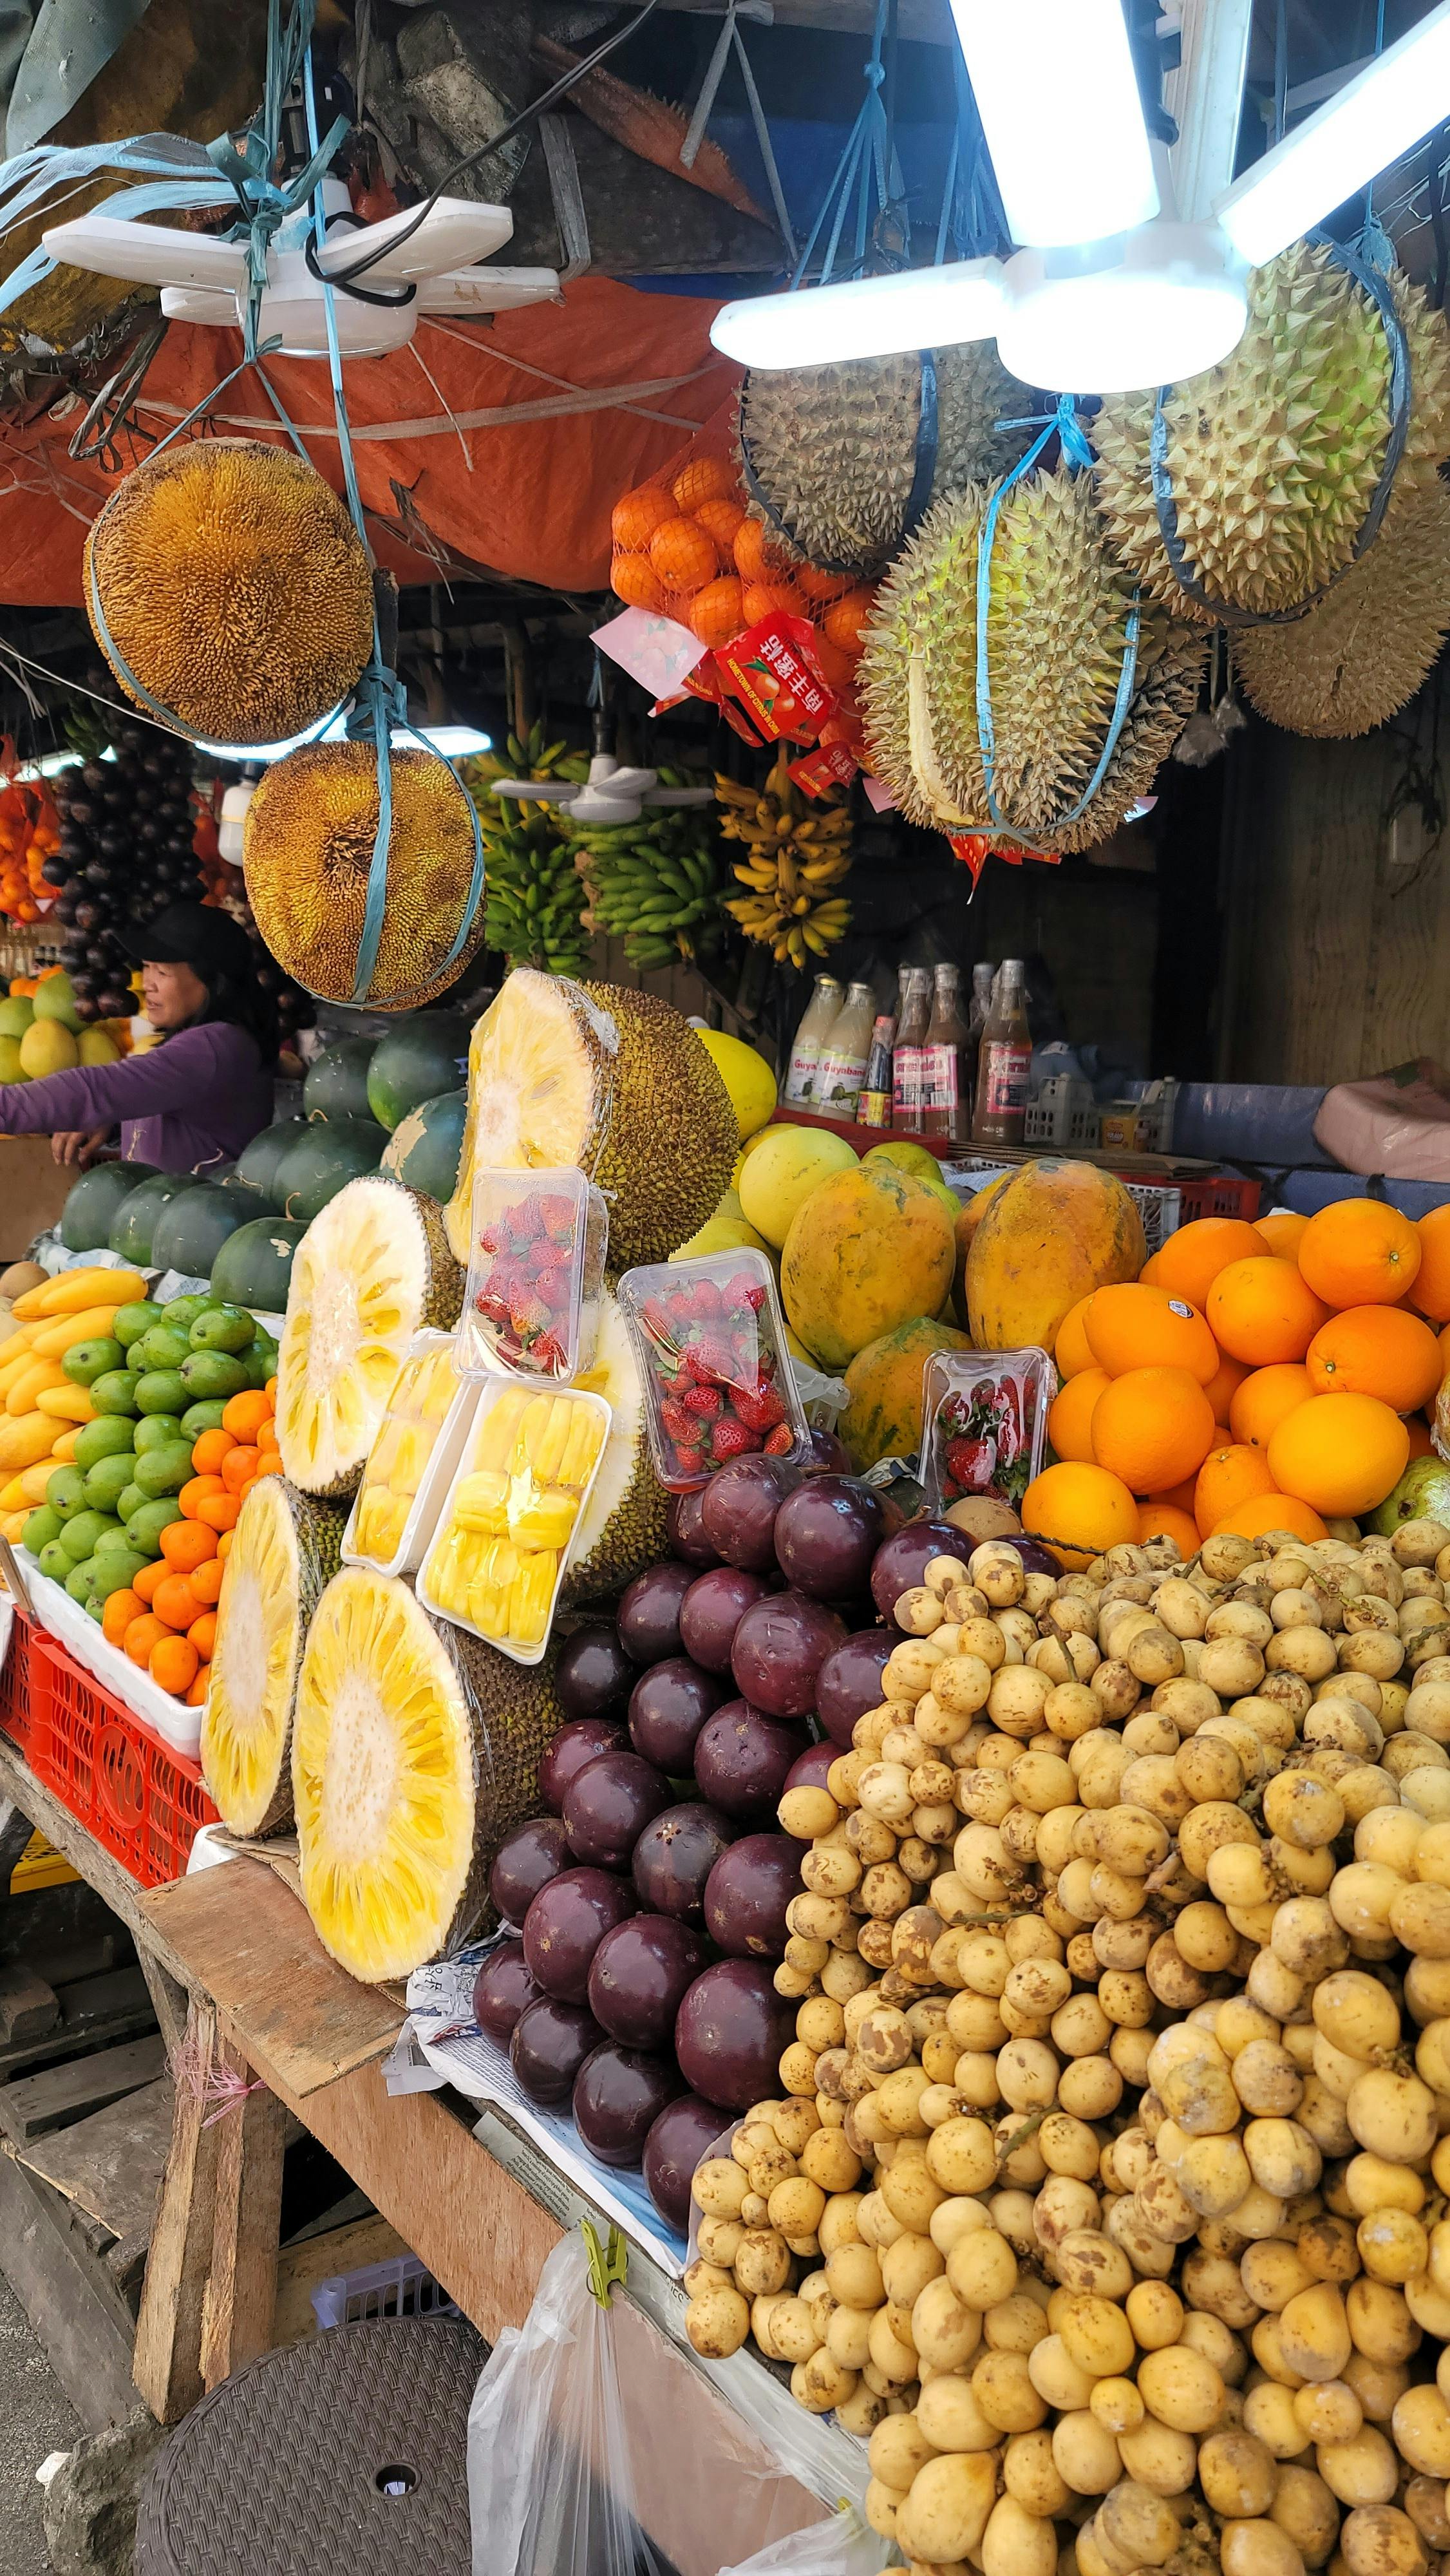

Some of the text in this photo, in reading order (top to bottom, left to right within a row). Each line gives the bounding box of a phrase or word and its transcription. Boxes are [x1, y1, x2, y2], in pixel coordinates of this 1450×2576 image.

[726, 658, 751, 692] HOMETOWN
[760, 635, 823, 715] 南丰蜜桔
[746, 689, 757, 700] OF
[751, 697, 769, 718] CITRUS
[763, 714, 773, 723] IN
